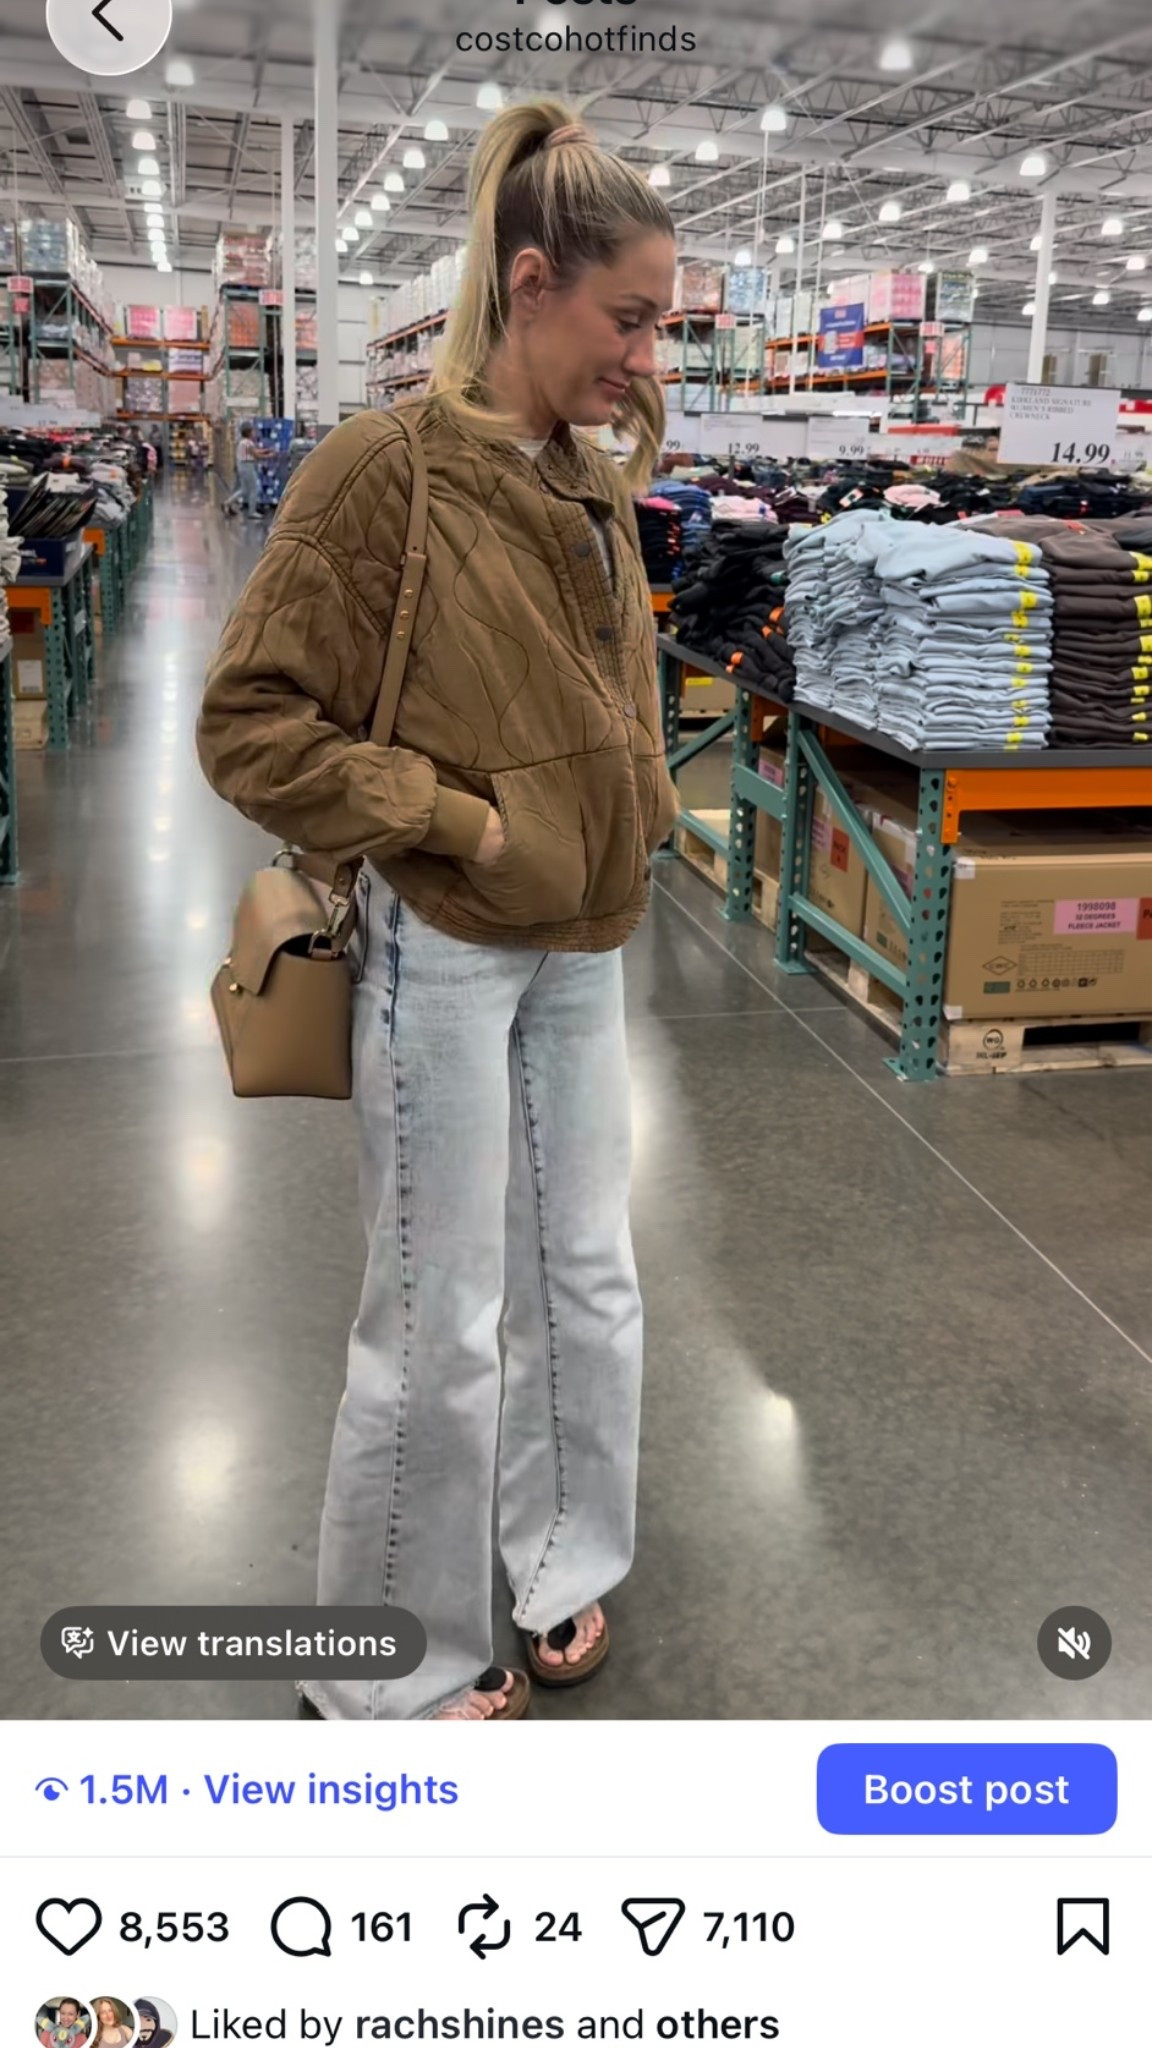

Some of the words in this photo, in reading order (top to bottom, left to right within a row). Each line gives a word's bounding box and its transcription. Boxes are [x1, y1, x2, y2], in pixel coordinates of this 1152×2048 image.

[728, 443, 760, 454] 12.99
[839, 445, 864, 456] 9.99
[1051, 442, 1110, 464] 14.99
[1096, 921, 1121, 929] JACKET
